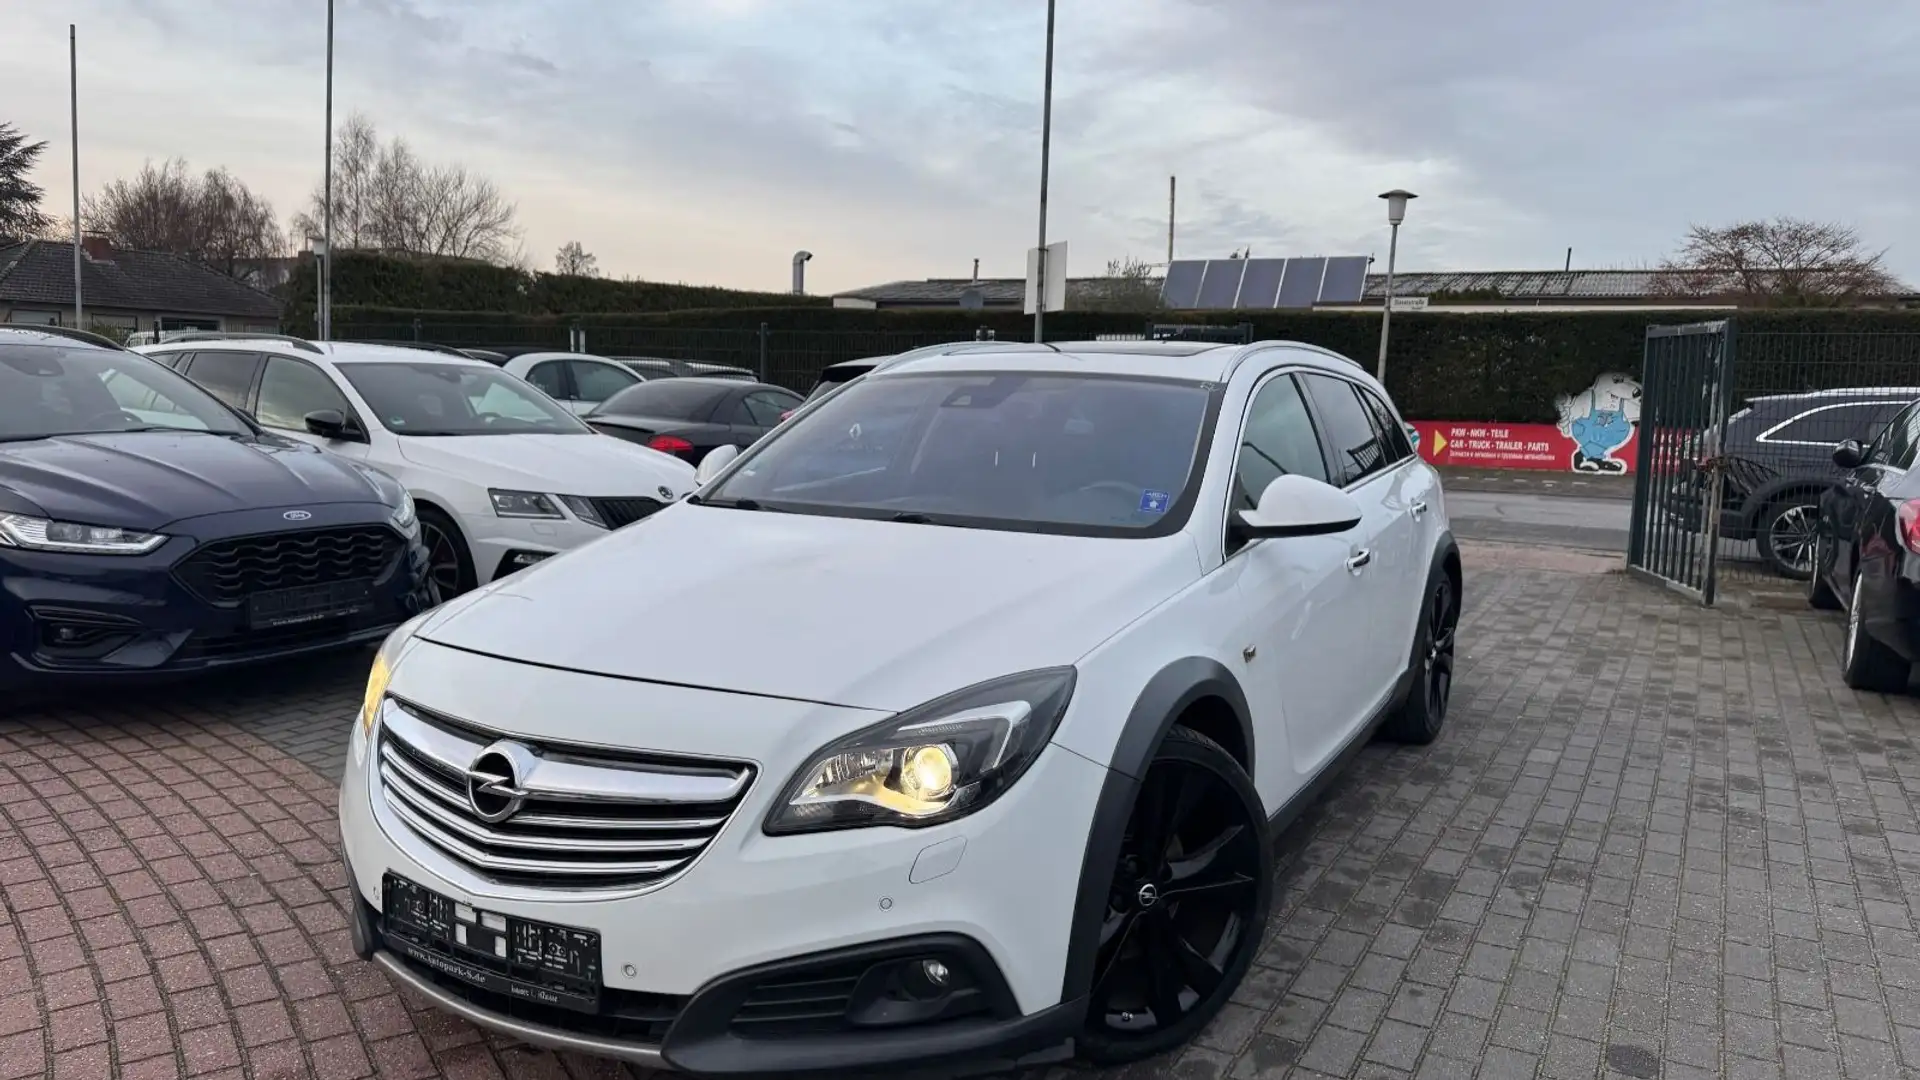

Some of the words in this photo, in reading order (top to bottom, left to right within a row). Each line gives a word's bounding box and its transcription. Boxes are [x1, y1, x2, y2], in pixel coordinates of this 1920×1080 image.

[1450, 428, 1466, 437] PKW
[1491, 429, 1509, 438] TEILE
[1450, 439, 1463, 449] CAR
[1468, 440, 1490, 449] TRUCK
[1495, 441, 1522, 451] TRAILER
[1527, 442, 1549, 452] PARTS
